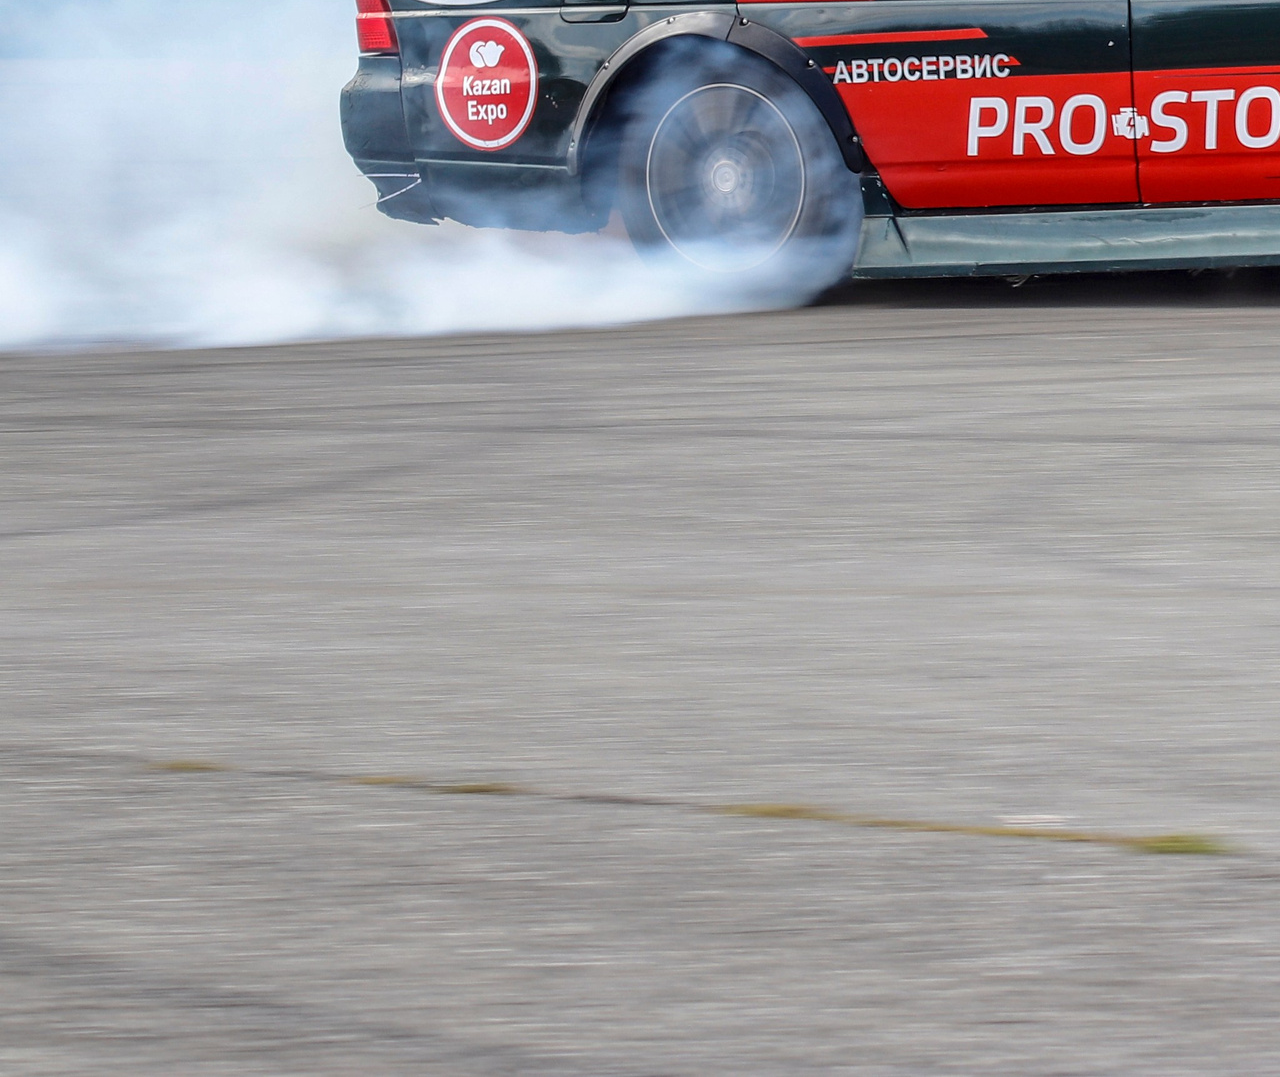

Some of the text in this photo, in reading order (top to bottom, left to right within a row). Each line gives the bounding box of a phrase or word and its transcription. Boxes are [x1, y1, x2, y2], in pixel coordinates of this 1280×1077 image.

[832, 53, 1011, 85] АВТОСЕРВИС
[463, 75, 511, 96] Kazan
[467, 100, 507, 125] Expo
[966, 94, 1107, 157] PRO
